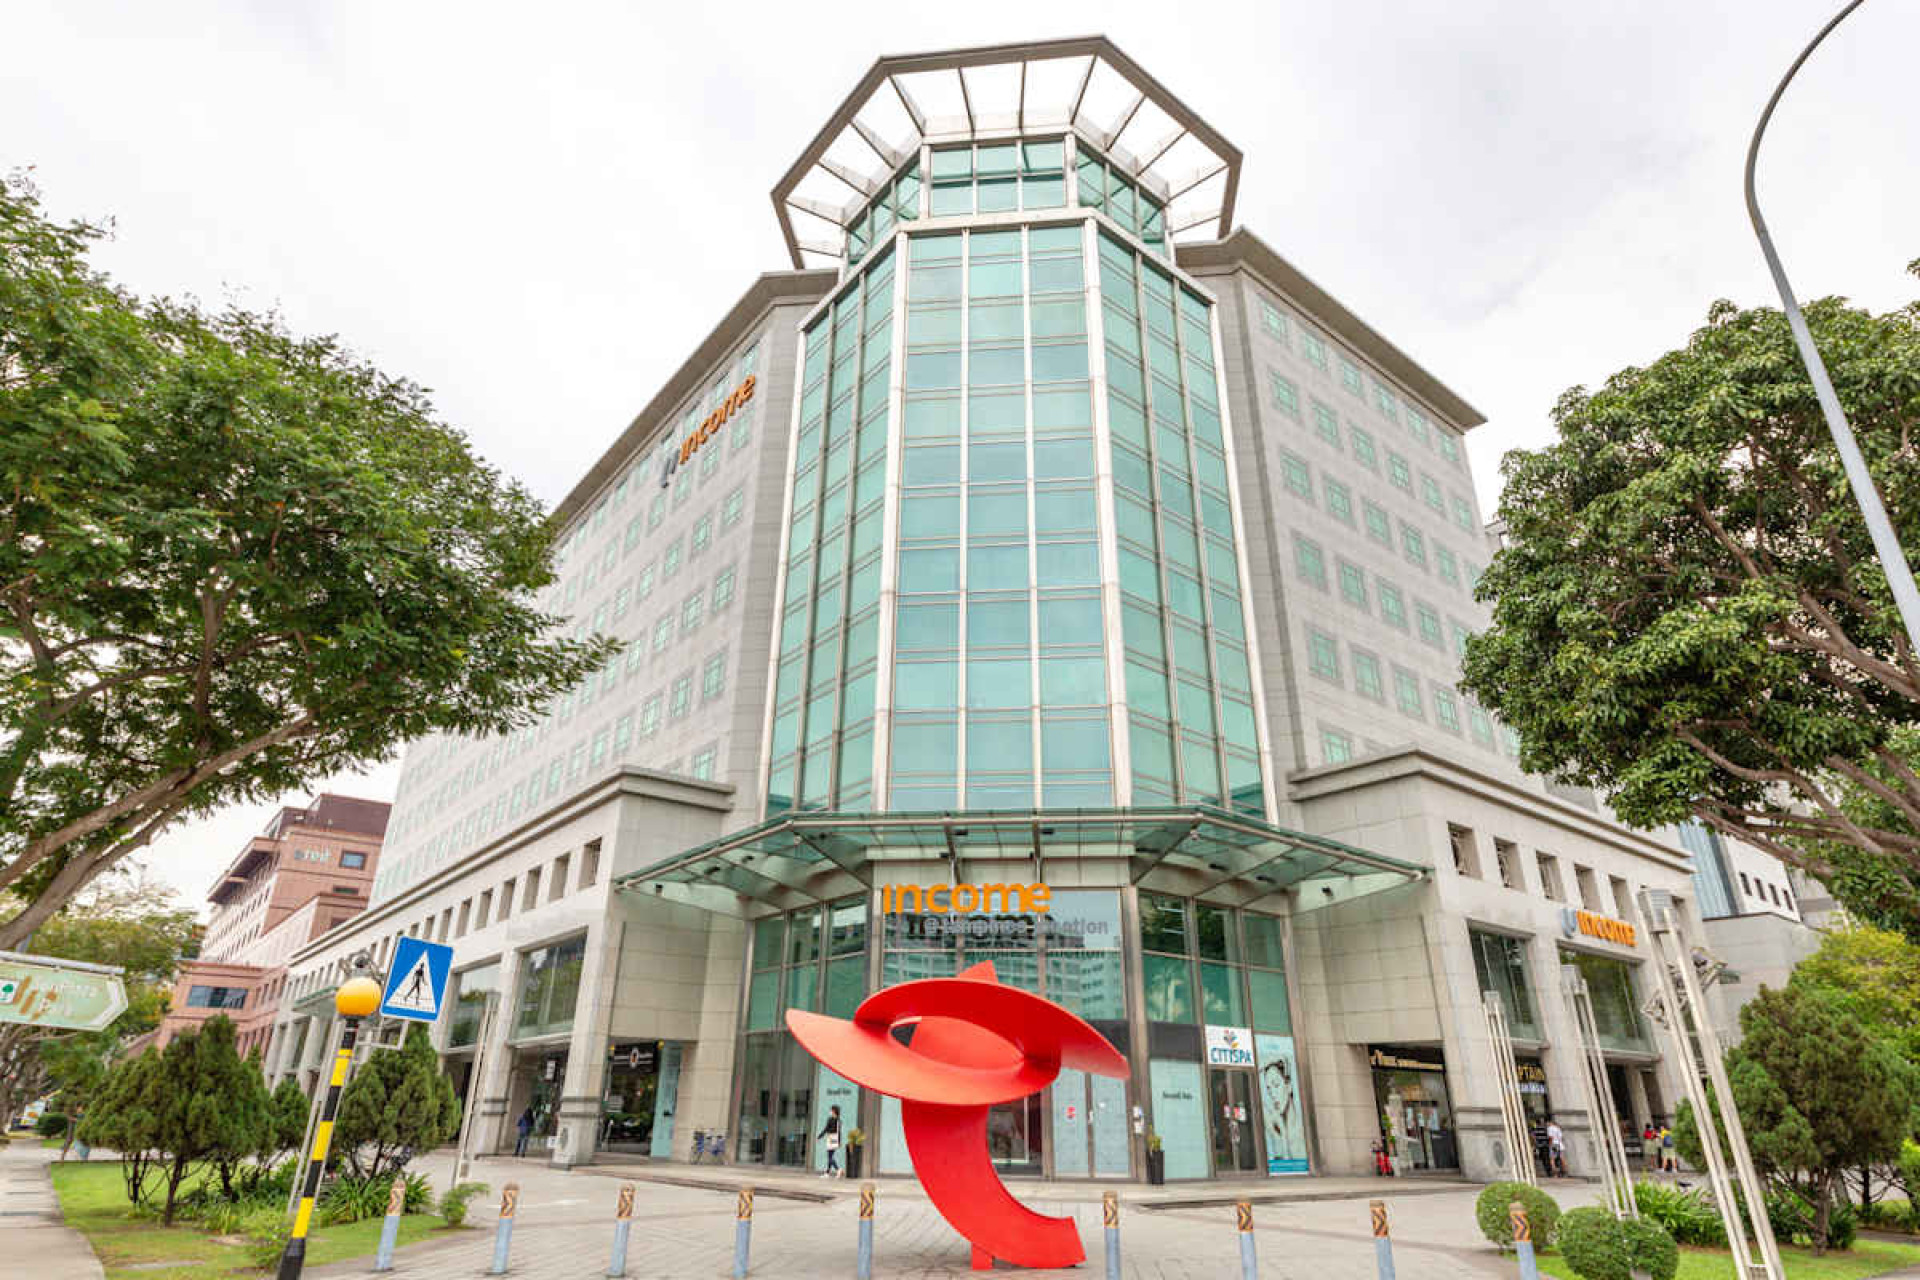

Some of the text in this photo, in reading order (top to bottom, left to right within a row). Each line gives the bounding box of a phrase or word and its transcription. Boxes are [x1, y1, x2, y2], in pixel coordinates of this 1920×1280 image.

[678, 375, 756, 465] income
[883, 882, 1053, 915] income
[1576, 909, 1639, 947] income
